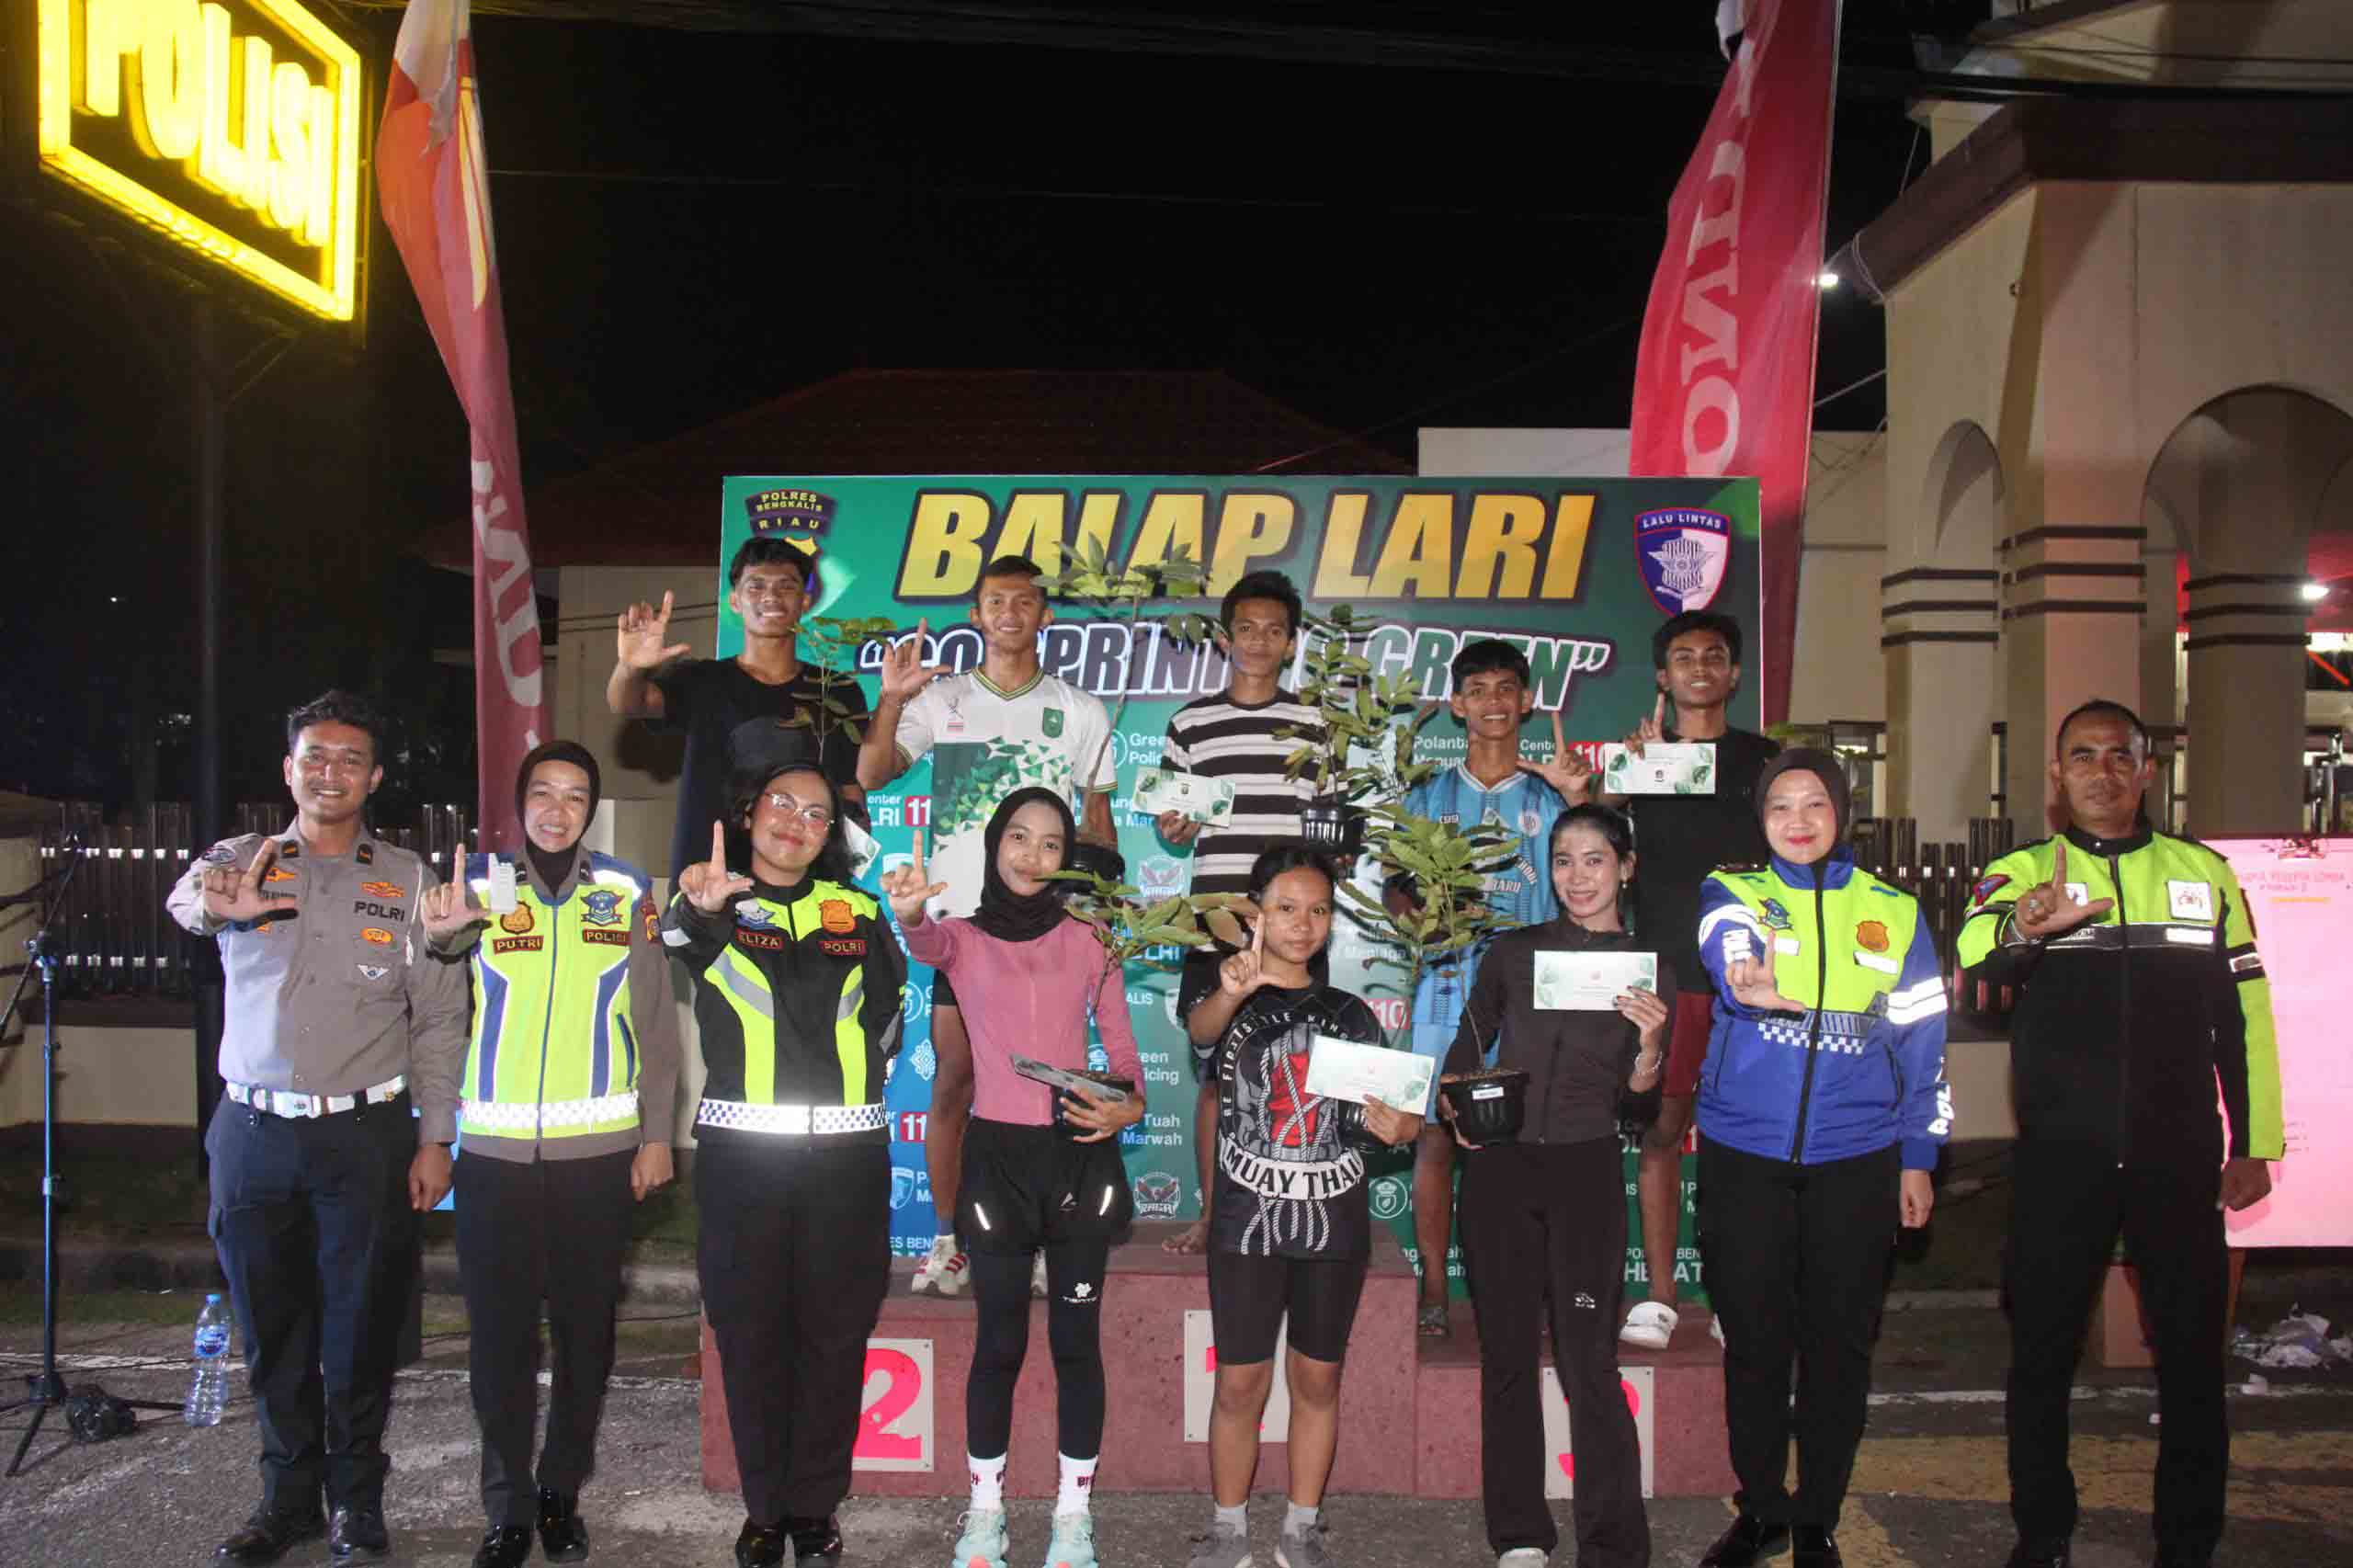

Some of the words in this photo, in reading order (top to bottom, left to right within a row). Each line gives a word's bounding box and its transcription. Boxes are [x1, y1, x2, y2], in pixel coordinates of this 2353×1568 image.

[760, 491, 817, 504] POLRES
[756, 500, 823, 512] BENGKALIS
[758, 517, 820, 530] RIAU
[1643, 515, 1674, 528] LALU
[1678, 514, 1722, 528] LINTAS
[1311, 493, 1597, 600] LARI
[1129, 733, 1167, 746] Gree
[1413, 735, 1470, 751] Polant
[868, 794, 901, 805] enter
[906, 798, 931, 825] 11
[355, 901, 405, 922] POLRI
[496, 937, 540, 951] PUTRI
[1145, 1067, 1180, 1085] icing
[902, 1113, 926, 1141] 11
[1122, 1131, 1183, 1145] Marwah
[1225, 1146, 1297, 1195] MUAY
[1302, 1154, 1361, 1198] THAI
[851, 1347, 923, 1460] 2
